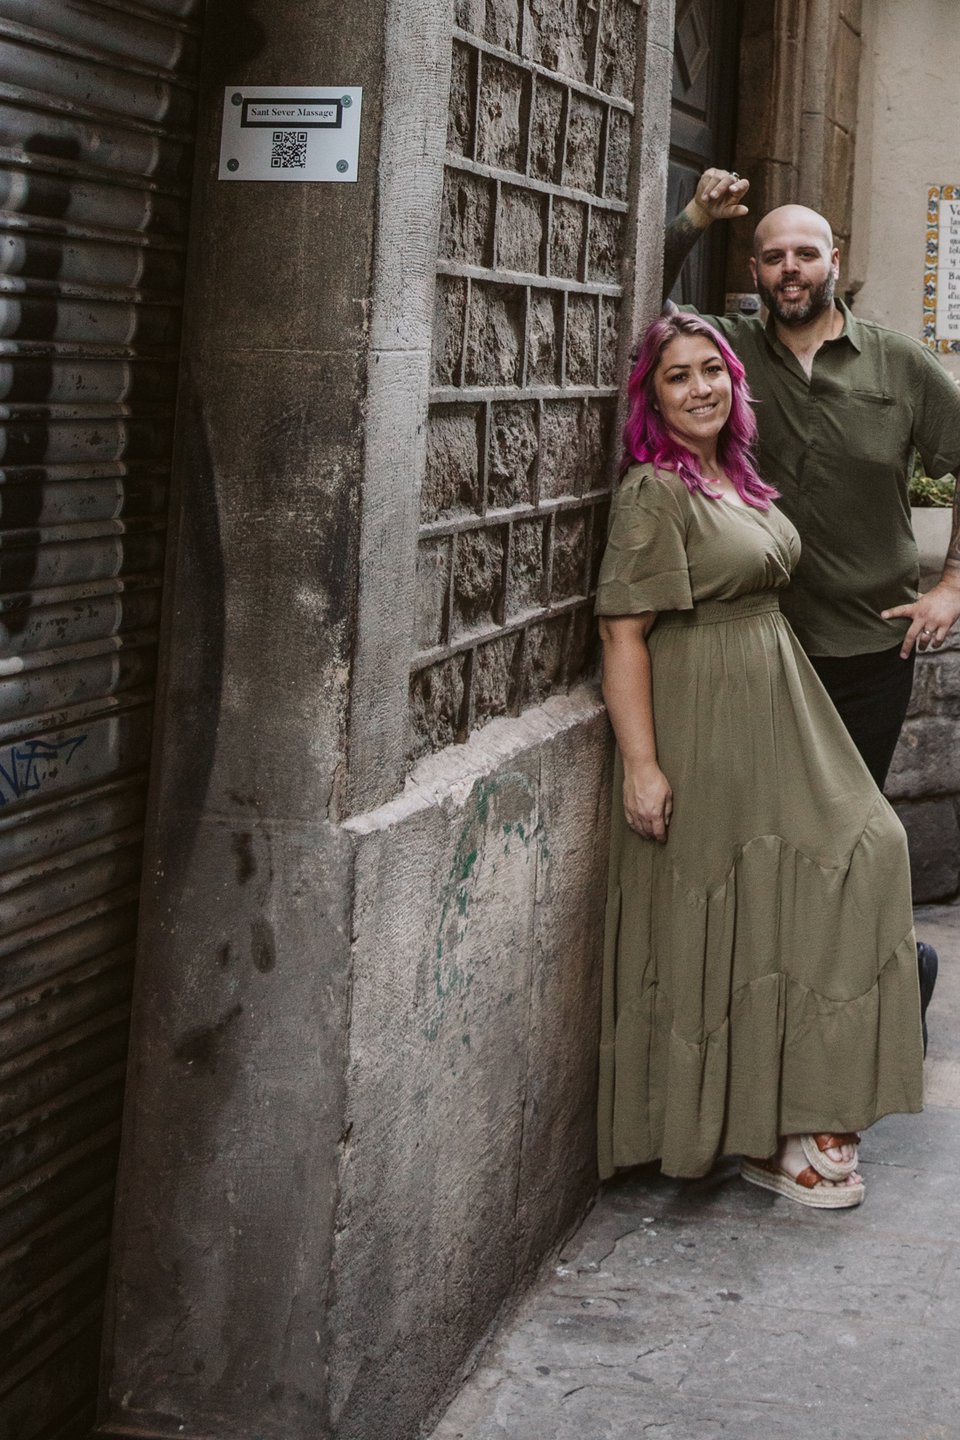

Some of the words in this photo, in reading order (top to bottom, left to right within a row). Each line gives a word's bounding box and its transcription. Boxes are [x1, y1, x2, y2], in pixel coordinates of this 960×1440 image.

[250, 107, 269, 117] Sant
[271, 107, 296, 117] Sever
[297, 108, 334, 119] Massage
